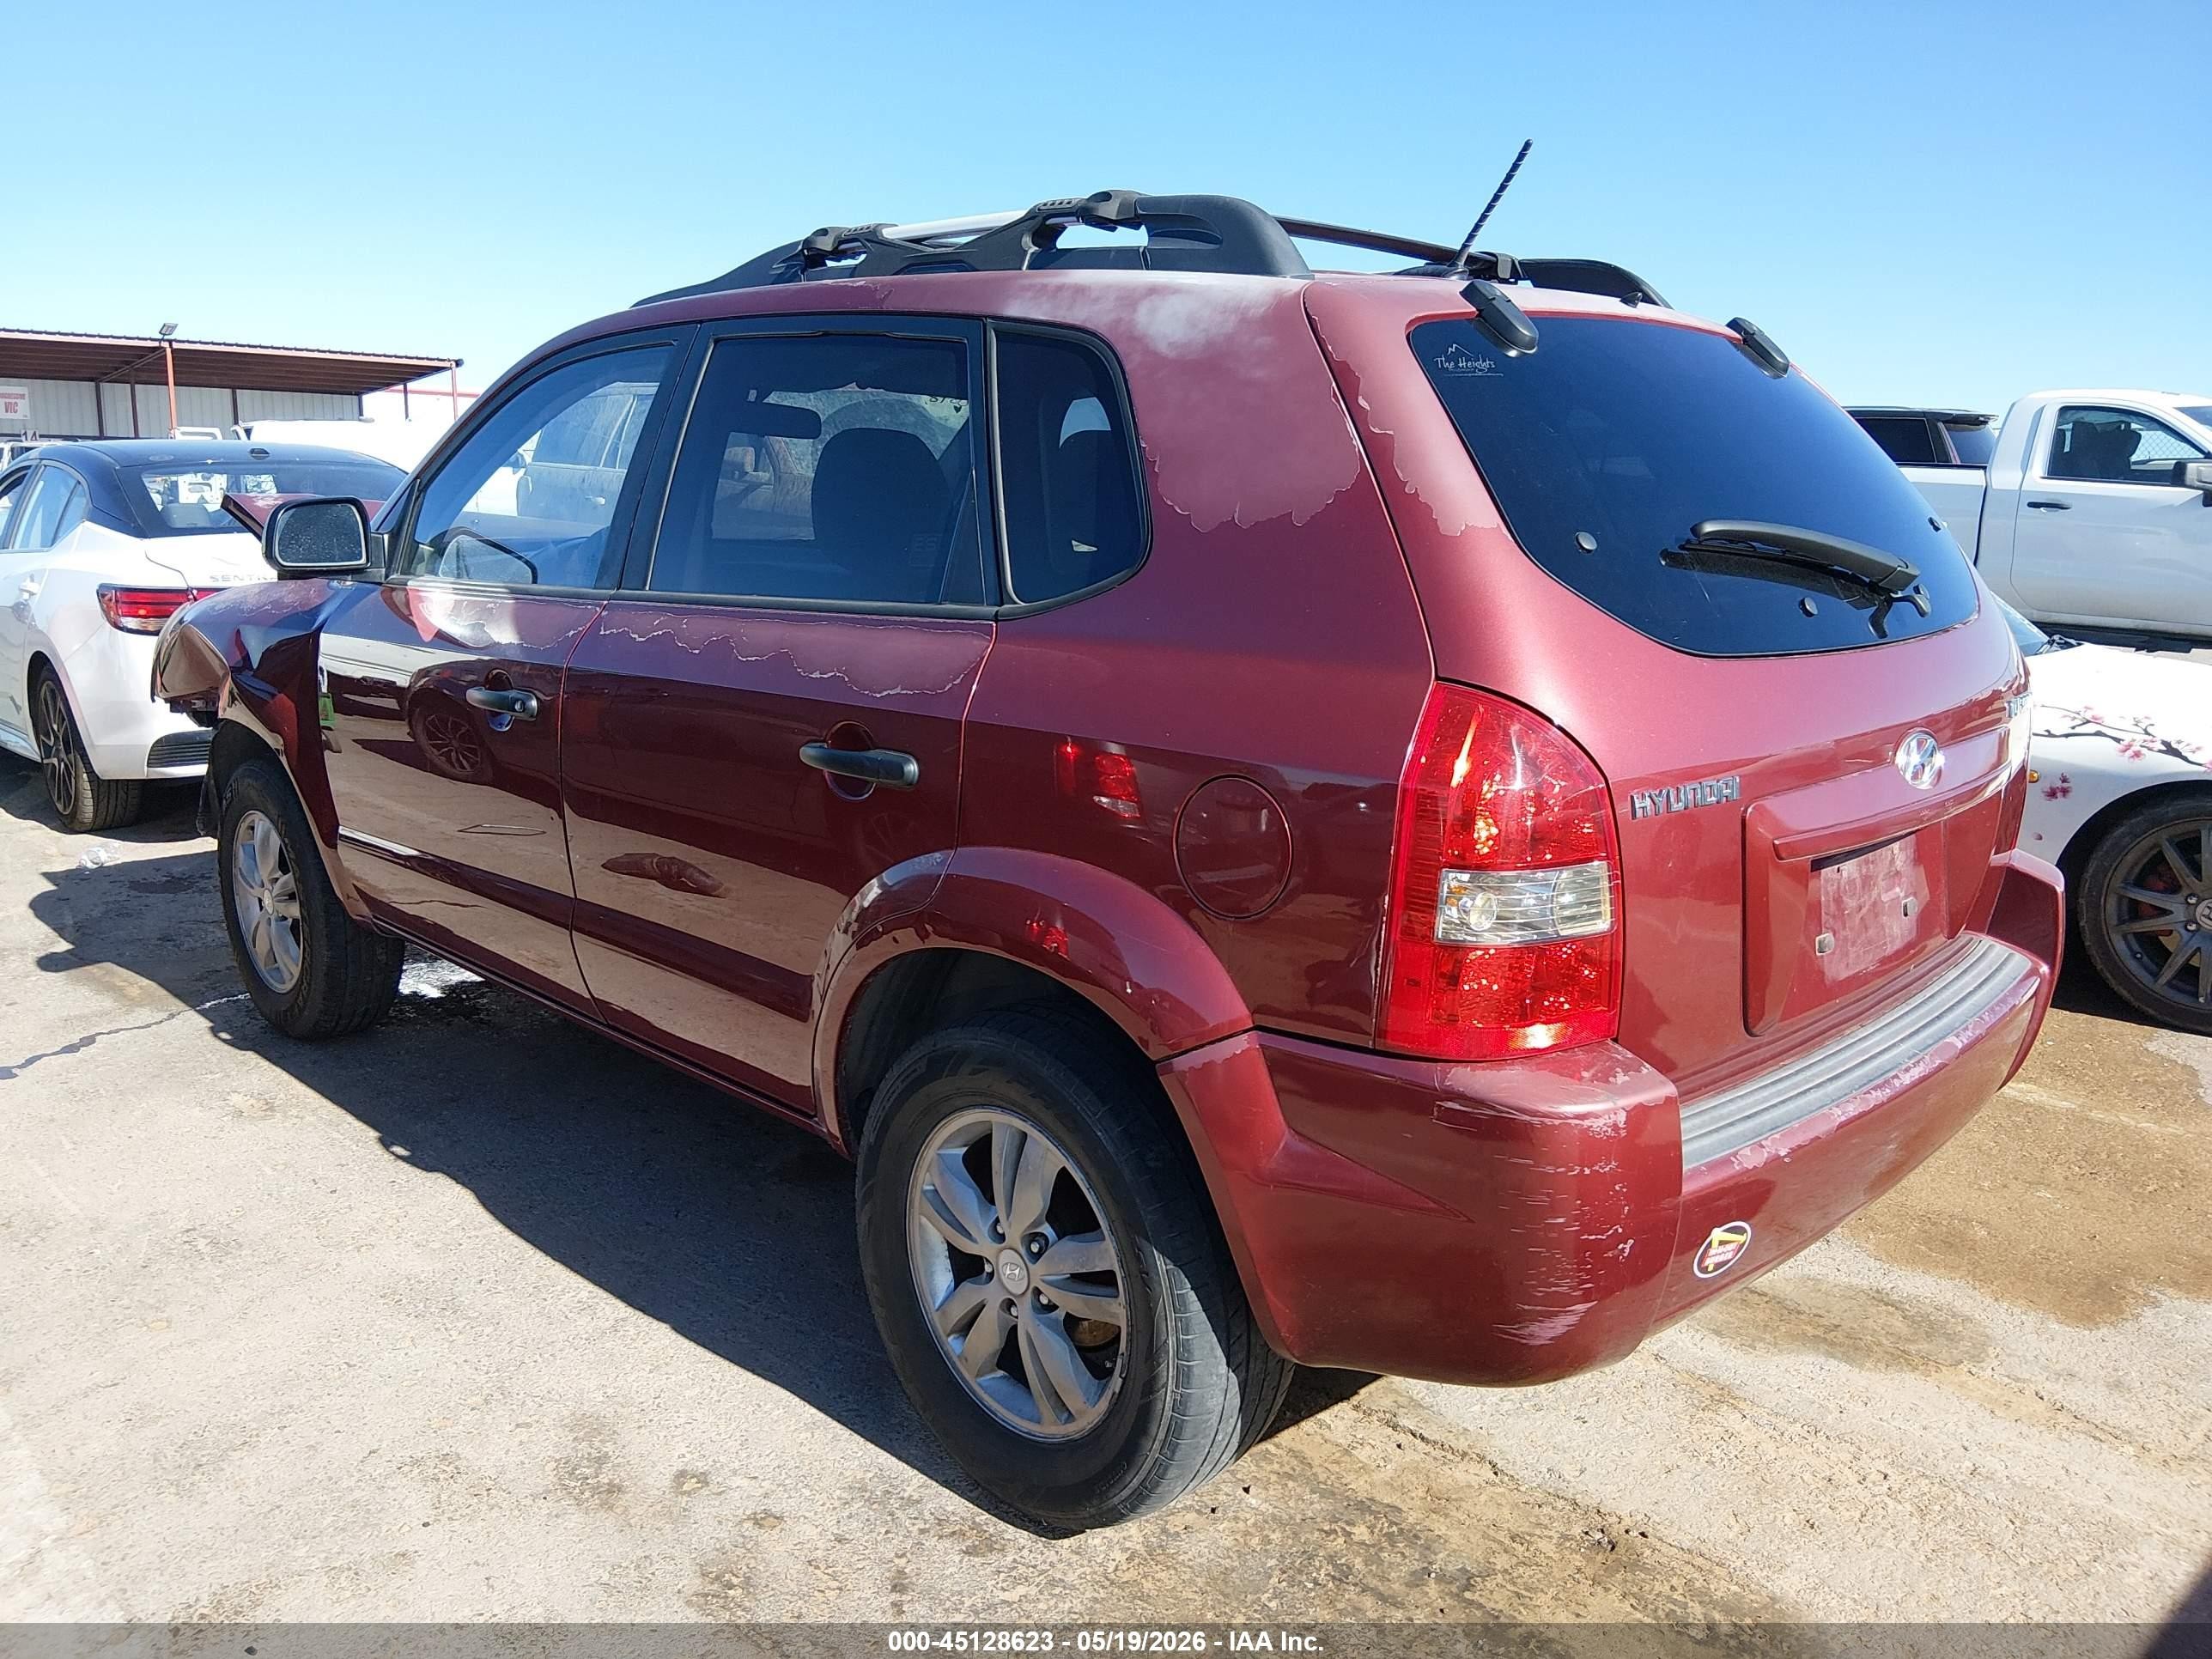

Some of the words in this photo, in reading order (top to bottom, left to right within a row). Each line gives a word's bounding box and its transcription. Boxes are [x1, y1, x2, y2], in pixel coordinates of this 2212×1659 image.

[1433, 355, 1455, 368] The
[1458, 354, 1495, 373] Heights
[4, 401, 18, 413] VIC
[21, 430, 38, 441] 14
[1631, 775, 1741, 820] HYUNDAI
